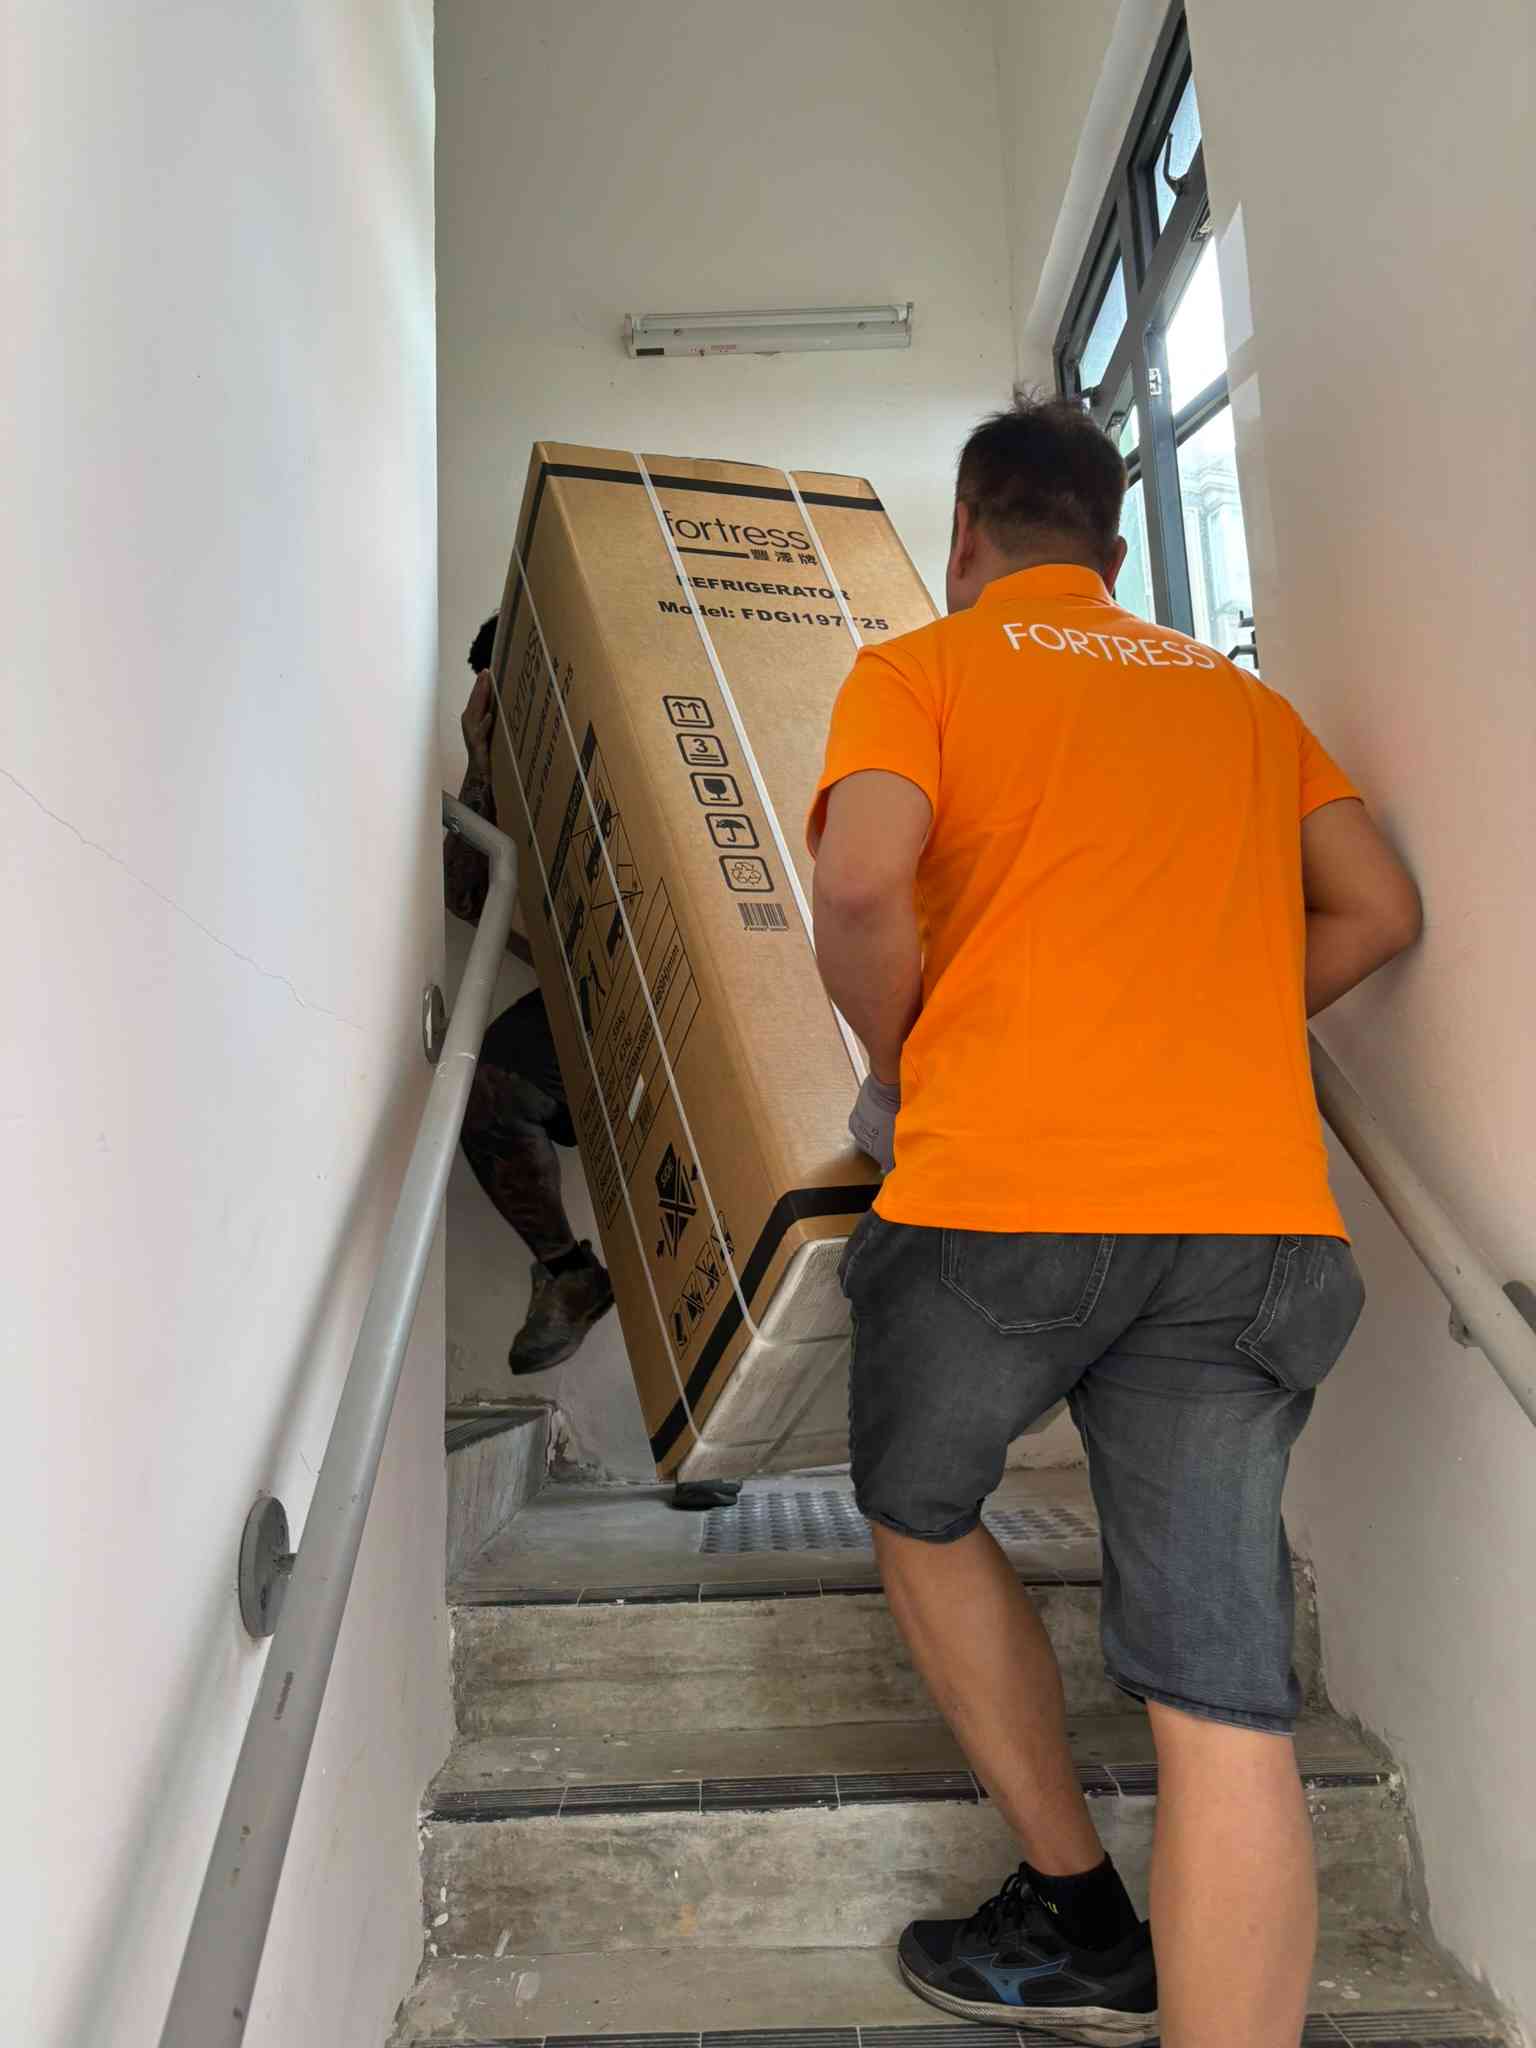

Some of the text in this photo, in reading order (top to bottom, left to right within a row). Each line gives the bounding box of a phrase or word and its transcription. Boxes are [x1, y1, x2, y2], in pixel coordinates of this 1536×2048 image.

[663, 510, 811, 551] fortress
[741, 608, 889, 630] FDGI19725
[1003, 623, 1216, 669] FORTRESS
[693, 738, 708, 753] 3
